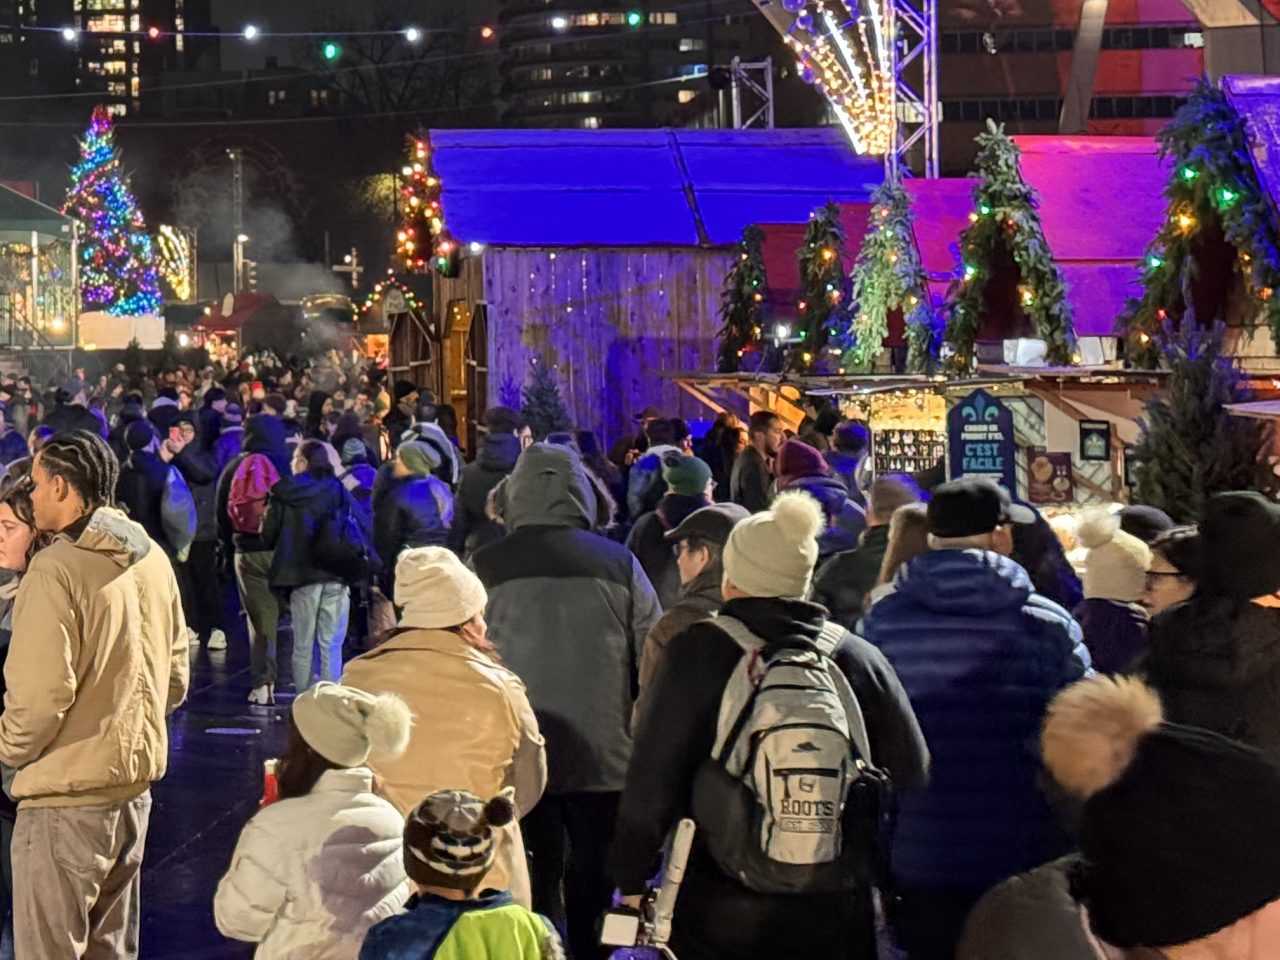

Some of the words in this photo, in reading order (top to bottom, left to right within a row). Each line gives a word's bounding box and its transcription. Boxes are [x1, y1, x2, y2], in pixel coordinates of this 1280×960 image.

[965, 443, 999, 457] C'EST
[962, 457, 1004, 471] FACILE
[780, 799, 834, 816] ROOTS
